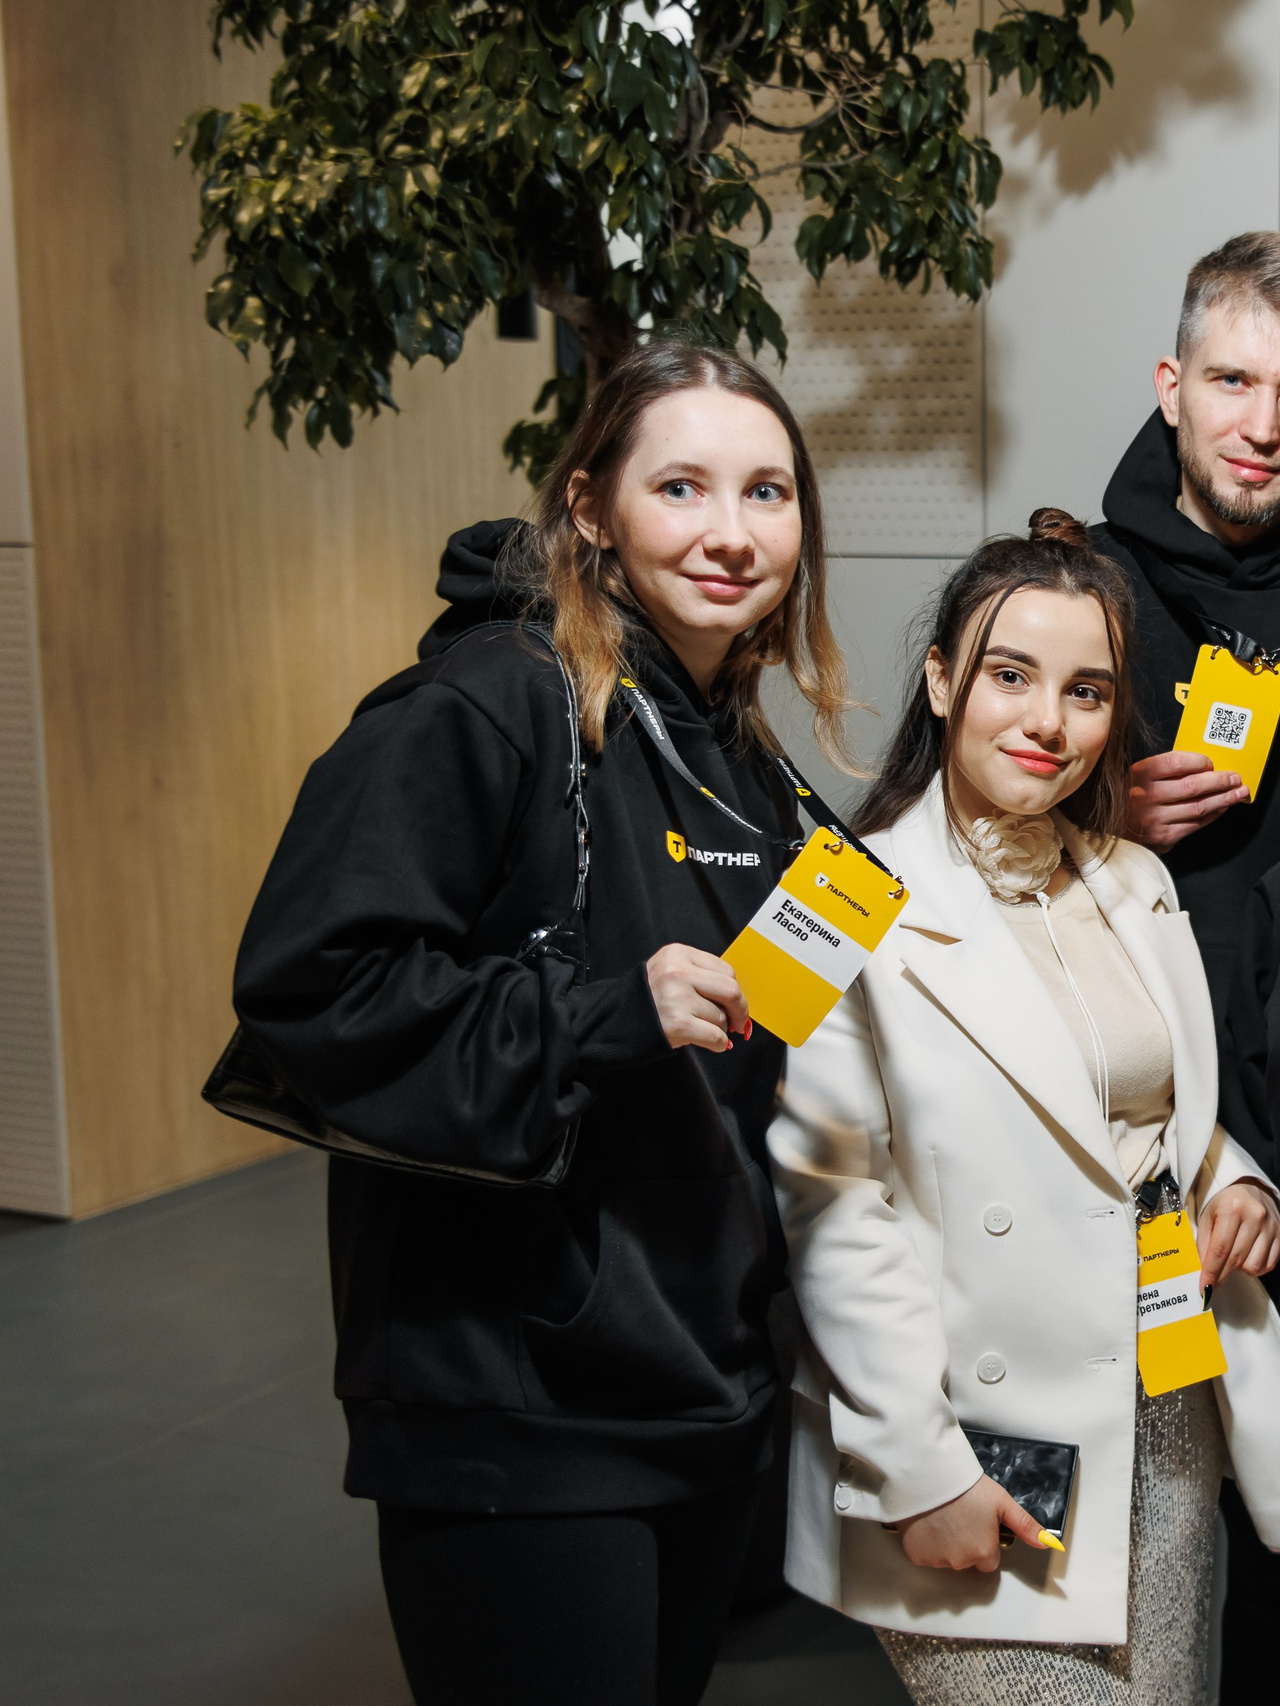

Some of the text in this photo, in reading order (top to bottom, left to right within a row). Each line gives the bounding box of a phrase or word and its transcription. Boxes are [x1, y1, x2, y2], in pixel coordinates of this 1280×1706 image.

[631, 688, 664, 740] ПАРТНЕРЫ
[826, 884, 870, 918] ПАРТНЕРЫ
[772, 911, 808, 942] Ласло
[781, 899, 840, 948] Екатерина
[1143, 1248, 1180, 1262] ПАРТНЕРЫ
[1136, 1290, 1160, 1303] лена
